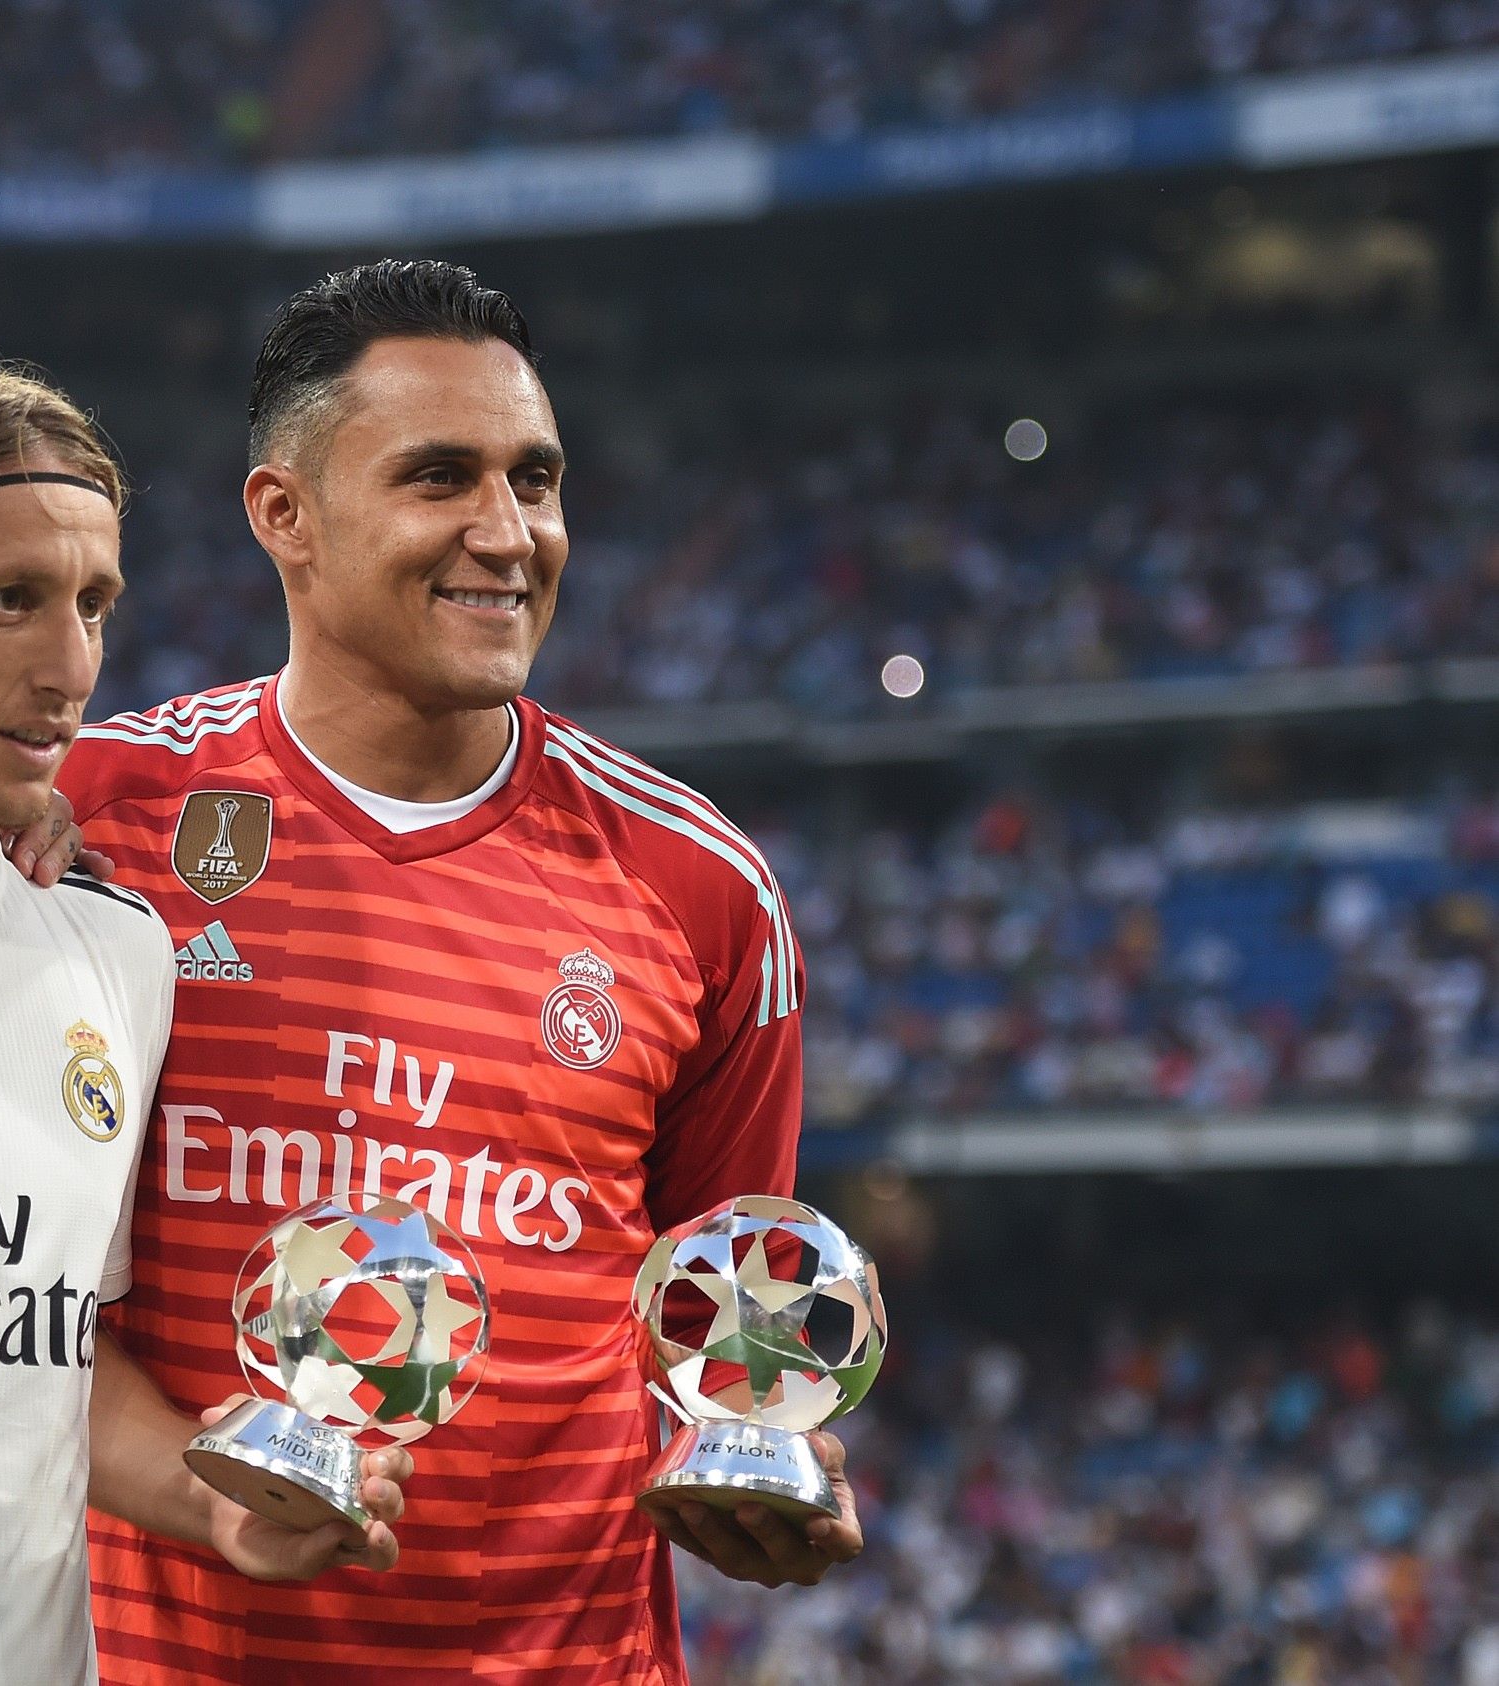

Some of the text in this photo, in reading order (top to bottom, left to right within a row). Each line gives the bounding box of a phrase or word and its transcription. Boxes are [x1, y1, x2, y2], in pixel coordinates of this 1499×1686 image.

[198, 859, 238, 874] FIFA
[202, 880, 228, 889] 2017
[210, 874, 247, 882] CHAMPIONS
[175, 959, 254, 982] didas
[326, 1030, 454, 1128] Fly
[161, 1104, 590, 1252] Emirates
[698, 1443, 776, 1460] KEYLOR
